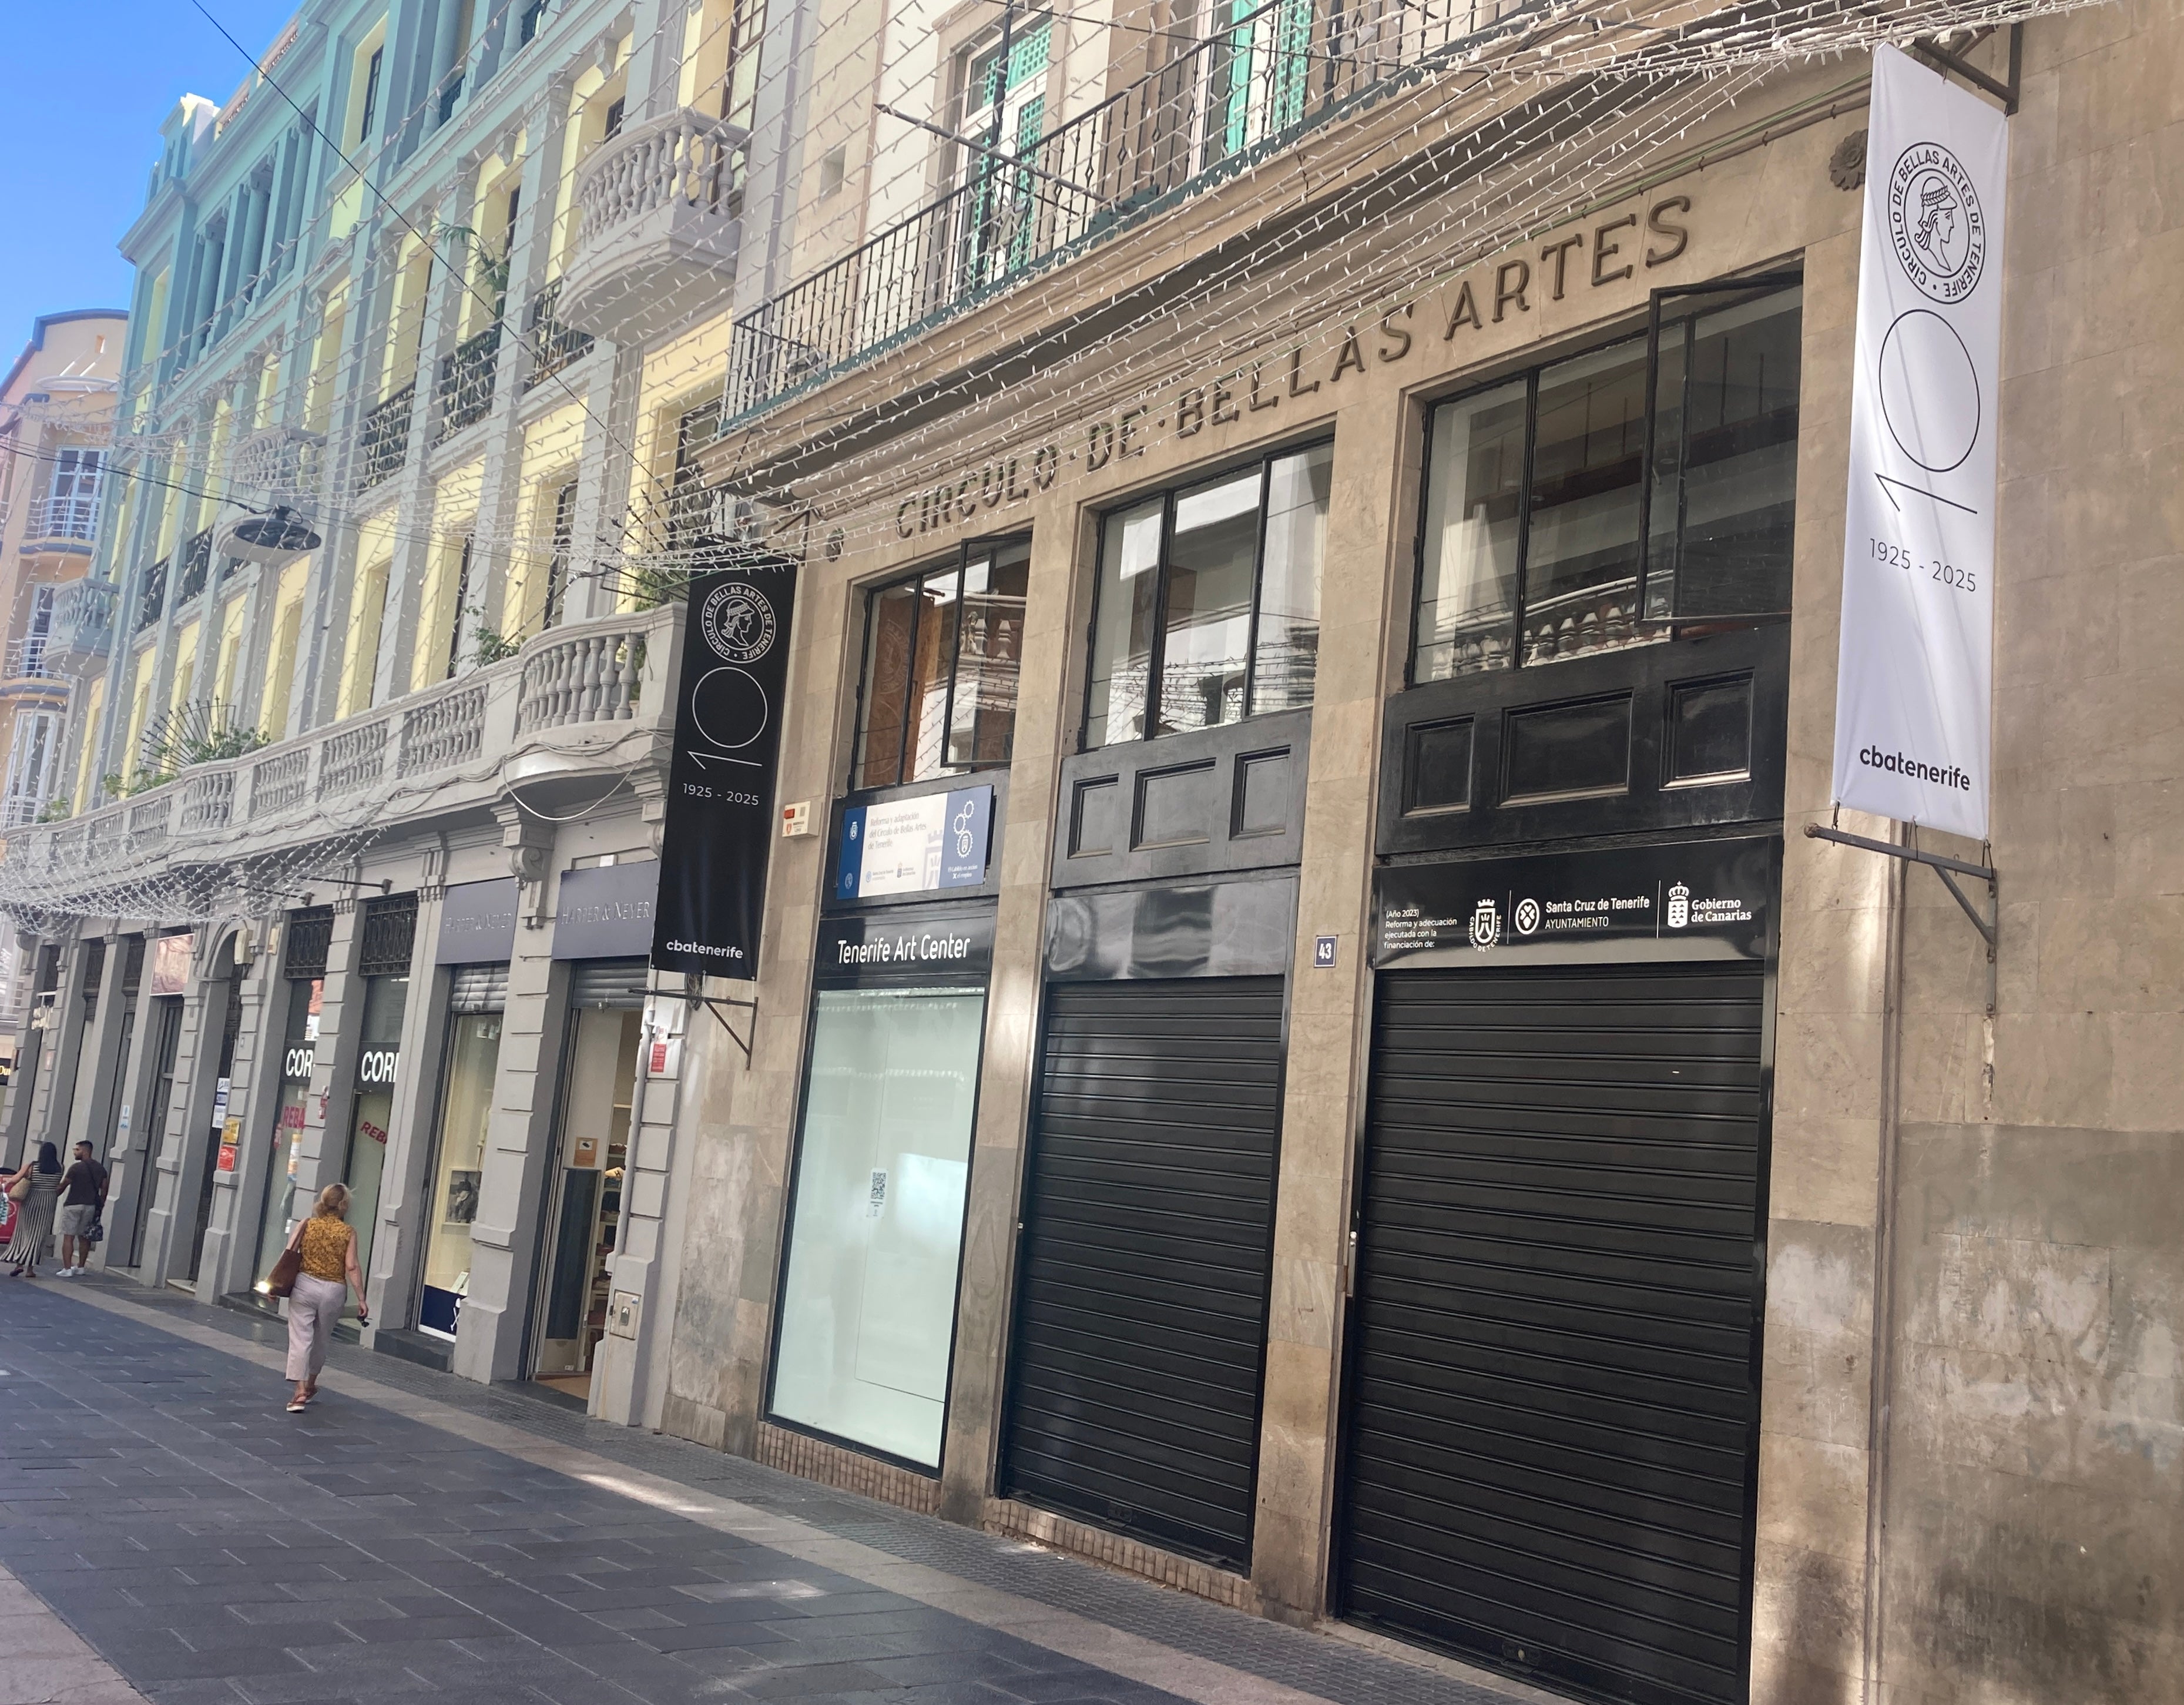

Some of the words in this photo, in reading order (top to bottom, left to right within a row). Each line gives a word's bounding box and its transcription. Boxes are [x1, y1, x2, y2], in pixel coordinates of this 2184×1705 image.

[1898, 149, 1940, 182] BELLAS
[1942, 157, 1974, 207] ARTES
[1893, 180, 1904, 206] DE
[1970, 212, 1981, 236] DE
[1943, 243, 1982, 297] TENERIFE
[1087, 404, 1148, 472] DE
[1176, 300, 1414, 440] BELLAS
[1443, 195, 1690, 340] ARTES
[1870, 538, 1911, 570] 1925
[1933, 561, 1976, 592] 2025
[710, 586, 742, 605] BELLAS
[743, 588, 768, 612] ARTES
[705, 605, 714, 619] DE
[764, 613, 773, 625] DE
[742, 628, 773, 660] TENERIFE
[1859, 745, 1970, 791] cbatenerife
[683, 783, 712, 798] 1925
[726, 791, 759, 806] 2025
[1546, 901, 1572, 913] Santa
[1574, 900, 1595, 912] Cruz
[1598, 899, 1609, 910] de
[1611, 896, 1650, 909] Tenerife
[1692, 898, 1742, 910] Gobierno
[561, 906, 599, 925] HARPER
[602, 905, 612, 921] &
[1386, 910, 1401, 920] (Año
[1402, 909, 1419, 918] 2023)
[1419, 918, 1457, 927] adecuación
[1545, 916, 1609, 929] AYUNTAMIENTO
[1691, 912, 1703, 922] de
[1705, 910, 1752, 922] Canarias
[1384, 931, 1415, 940] ejecutada
[1469, 916, 1478, 949] CABILDO
[1486, 915, 1502, 950] TENERIFE
[666, 939, 744, 959] cbatenerife
[837, 937, 891, 964] Tenerife
[893, 936, 917, 962] Art
[920, 933, 971, 960] Center
[1319, 943, 1331, 959] 43
[1384, 940, 1423, 949] financiación
